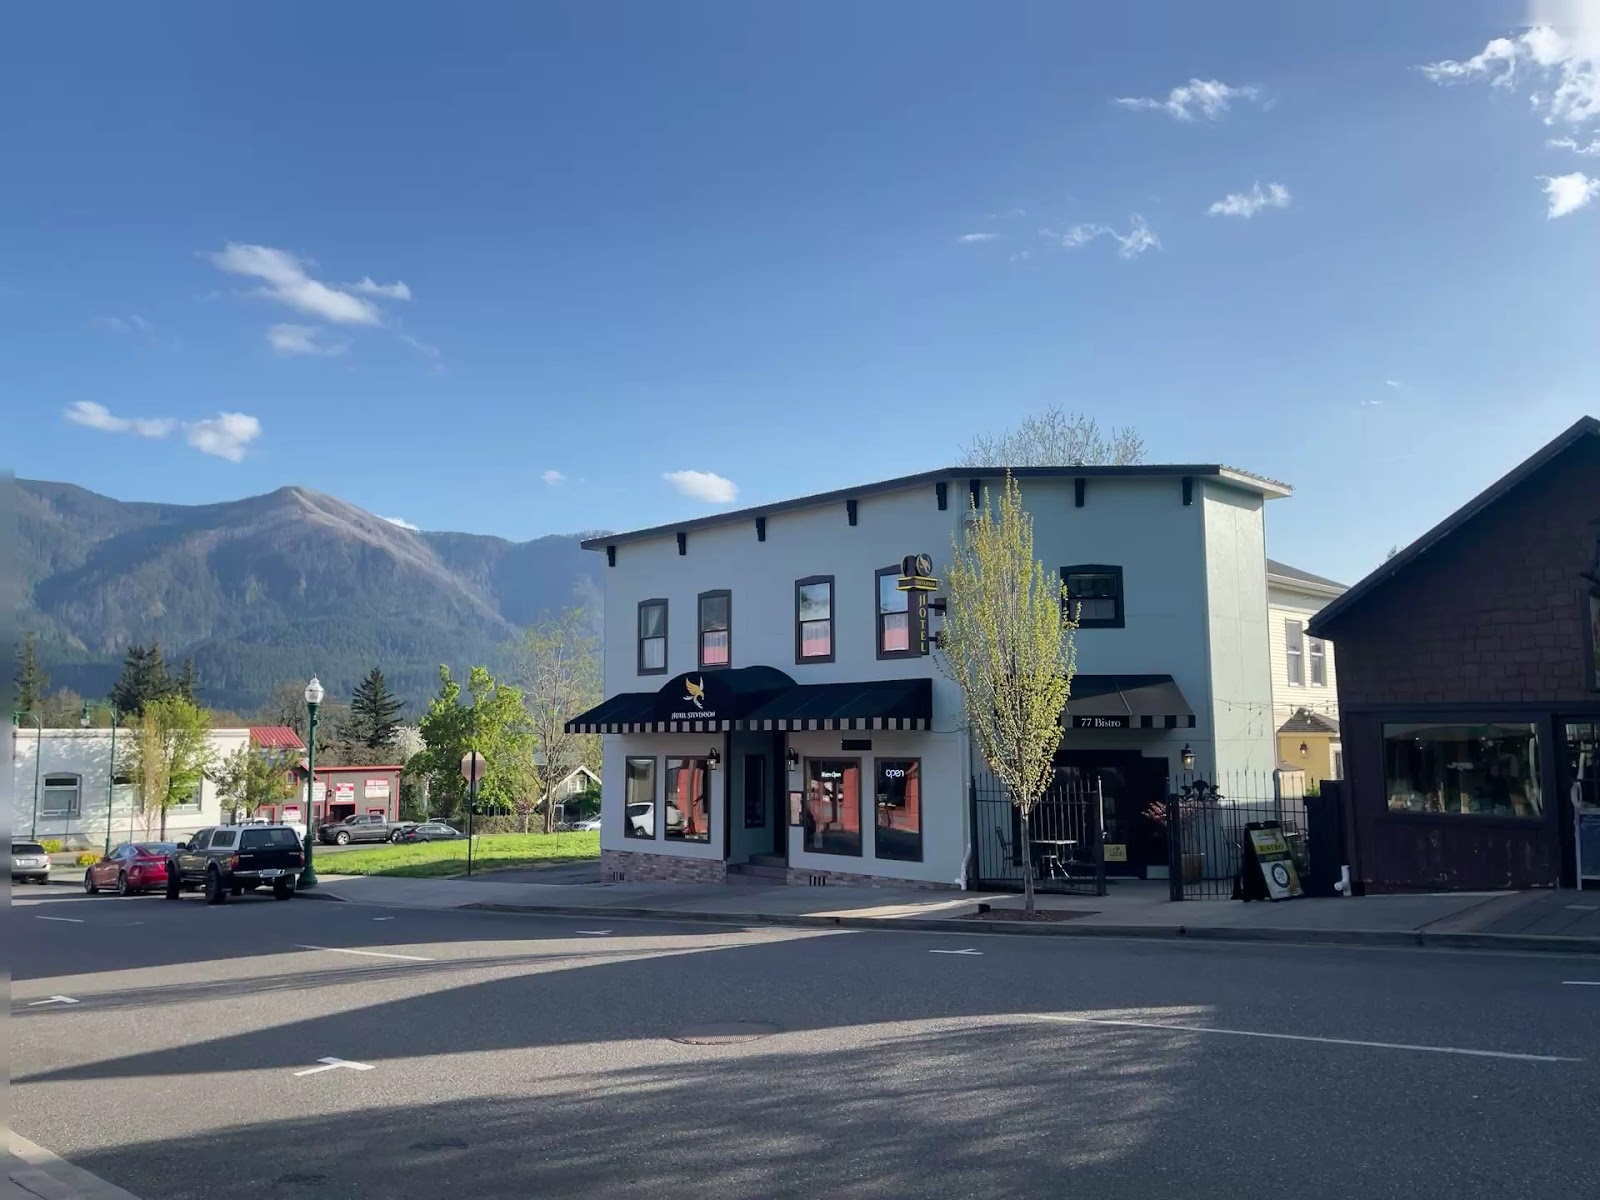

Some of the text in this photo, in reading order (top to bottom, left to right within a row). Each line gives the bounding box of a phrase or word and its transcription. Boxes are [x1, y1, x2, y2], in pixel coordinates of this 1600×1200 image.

[918, 593, 928, 652] HOTEL
[687, 711, 716, 719] STEVENSON
[1081, 717, 1121, 727] 77 Bistro
[885, 769, 905, 779] open
